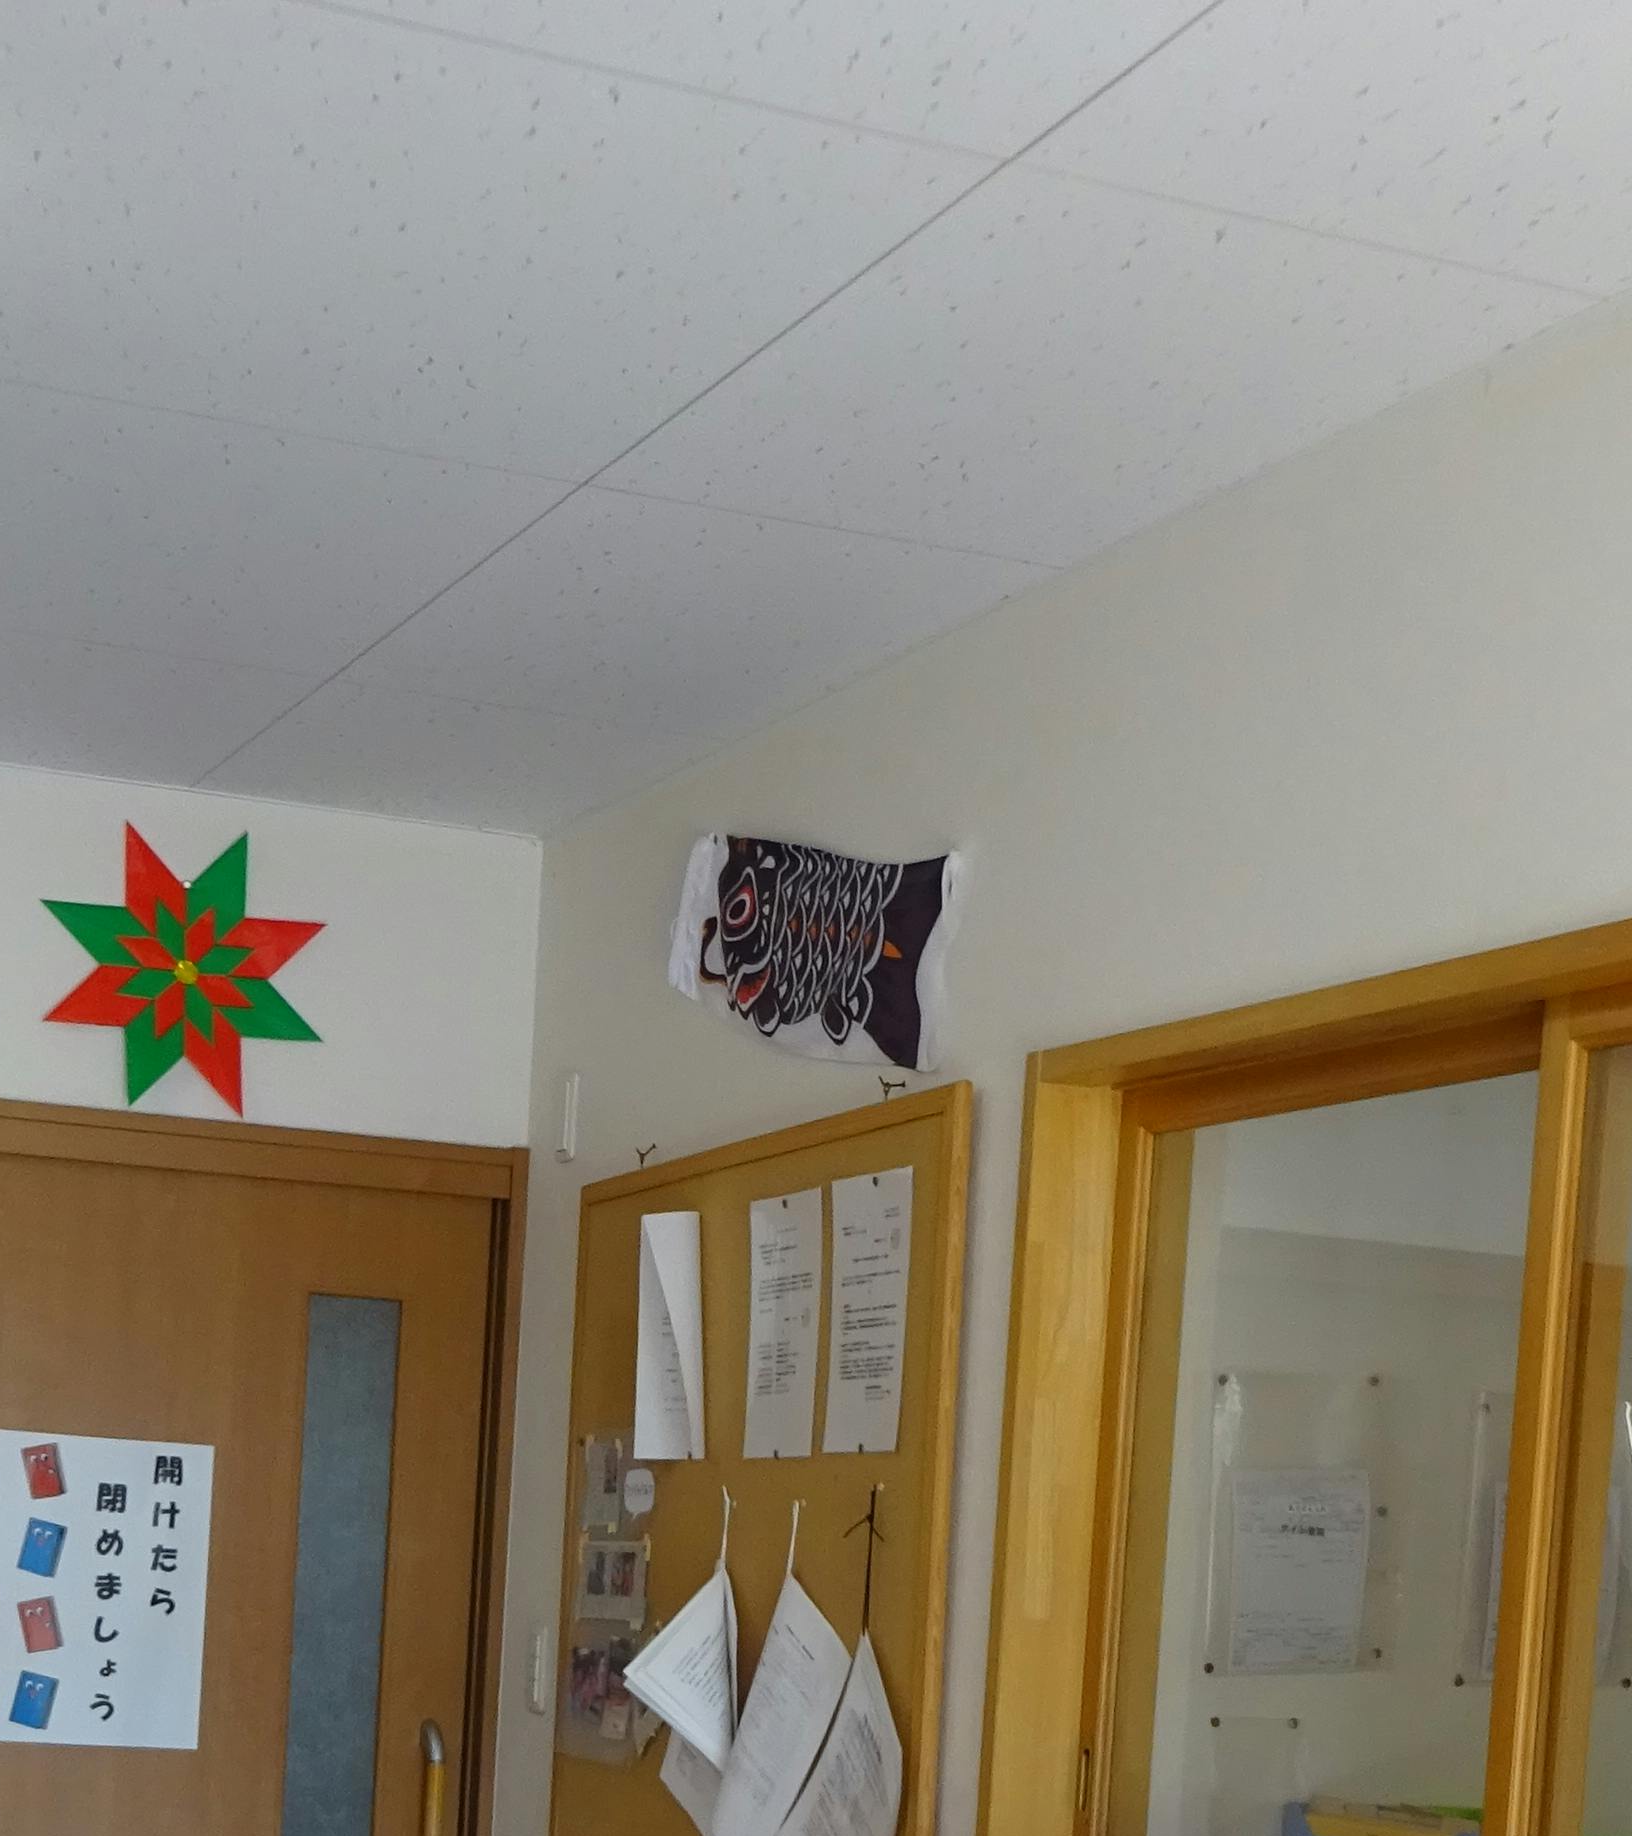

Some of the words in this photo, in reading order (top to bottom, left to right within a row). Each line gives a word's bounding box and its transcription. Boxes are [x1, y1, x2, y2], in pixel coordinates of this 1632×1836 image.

[89, 1483, 128, 1721] 閉めましょう
[150, 1455, 183, 1615] 開けたら
